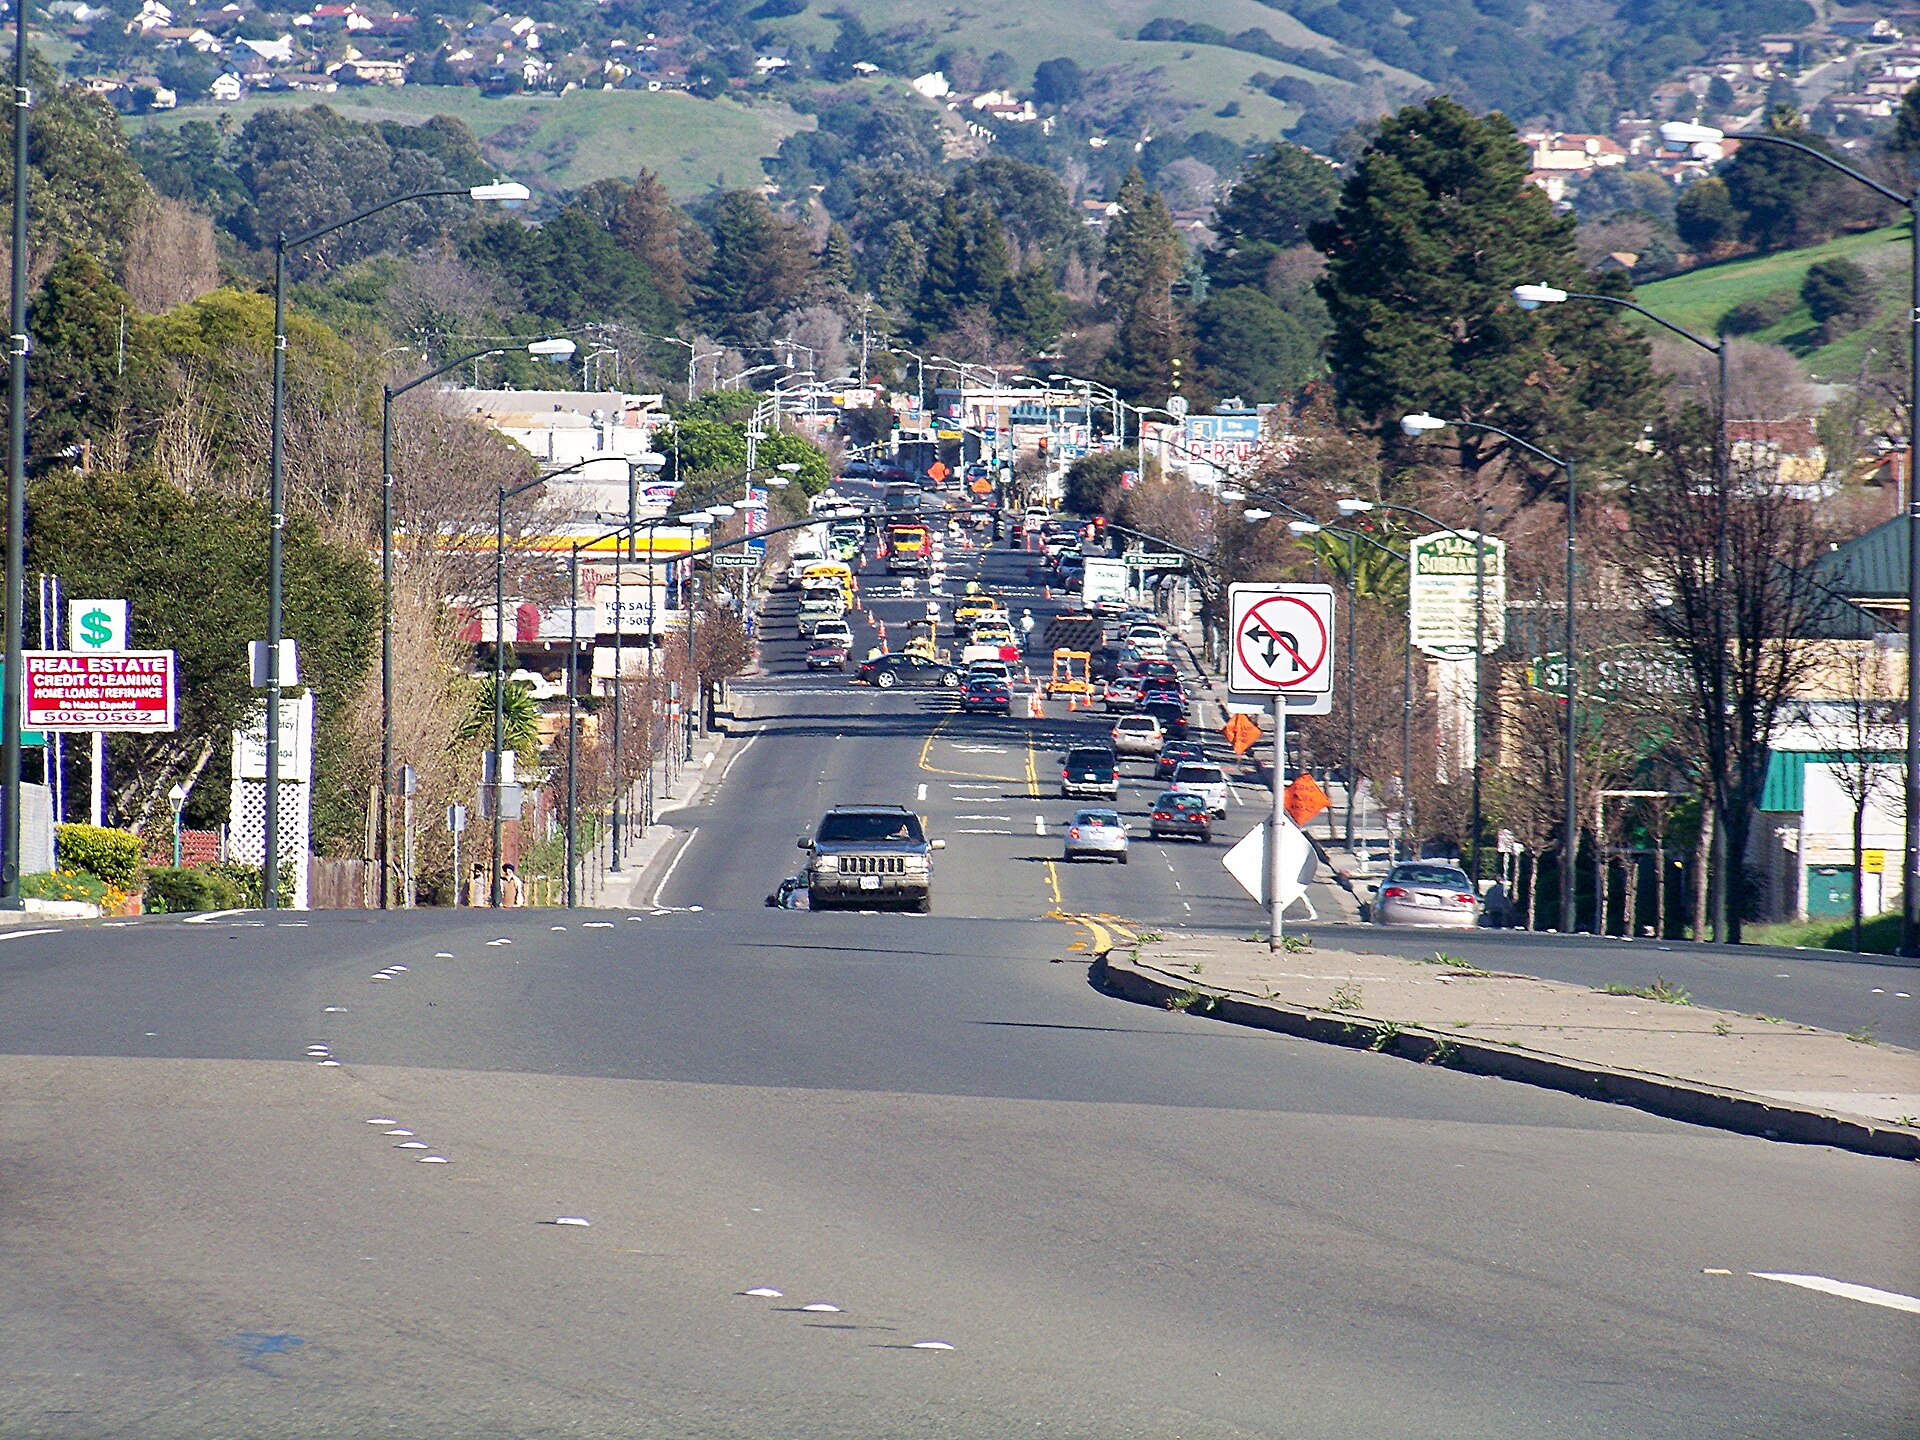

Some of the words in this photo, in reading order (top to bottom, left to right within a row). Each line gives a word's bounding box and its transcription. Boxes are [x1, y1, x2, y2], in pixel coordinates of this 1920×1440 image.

[605, 602, 626, 611] FOR
[628, 602, 657, 611] SALE
[30, 658, 85, 673] REAL
[87, 658, 166, 673] ESTATE
[33, 674, 88, 686] CREDIT
[89, 674, 162, 686] CLEANING
[34, 688, 64, 698] HOME
[65, 688, 99, 698] LOANS
[105, 688, 162, 698] REFINANCE
[44, 712, 151, 722] 506-0562
